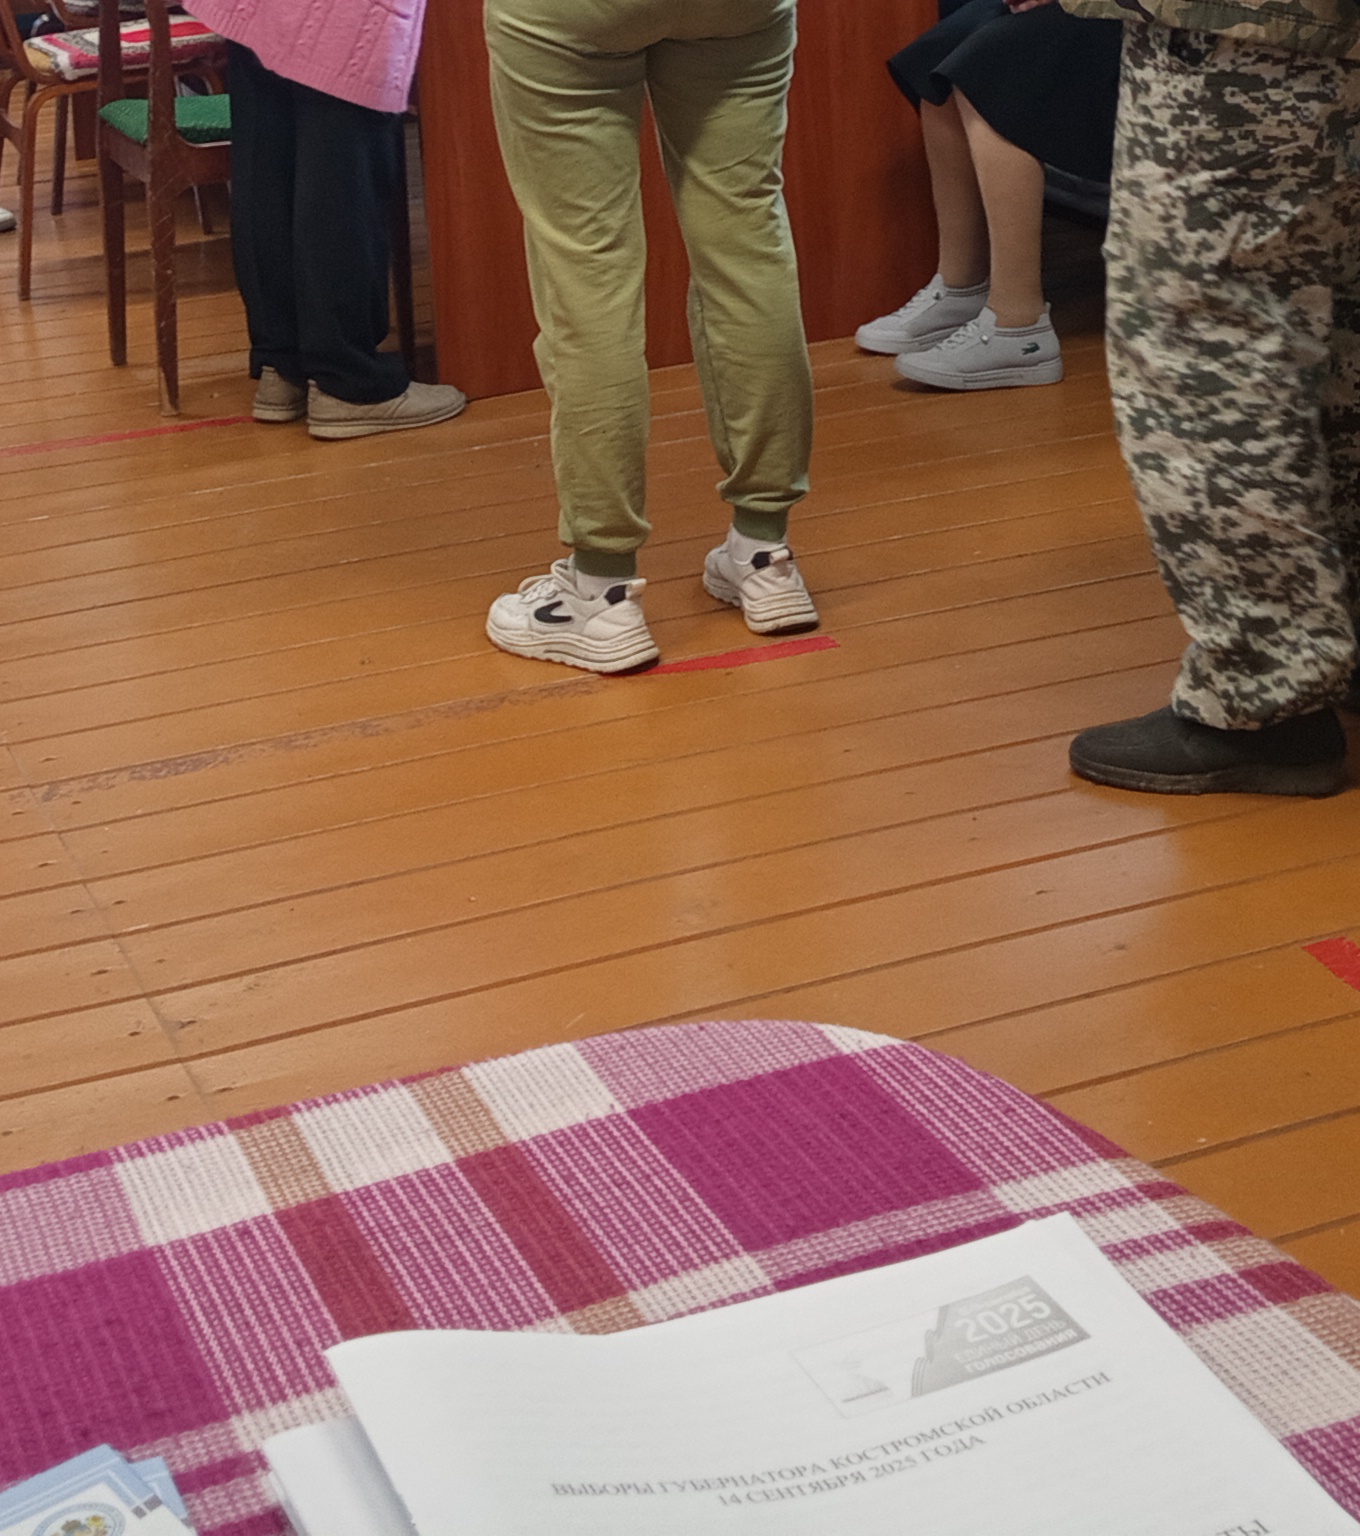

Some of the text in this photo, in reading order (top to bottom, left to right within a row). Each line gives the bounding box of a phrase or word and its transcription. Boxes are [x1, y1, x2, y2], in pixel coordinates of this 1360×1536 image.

[954, 1293, 1052, 1343] 2025
[1025, 1319, 1068, 1341] ДЕНЬ
[964, 1328, 1078, 1373] ГОЛОСОВАНИЯ
[550, 1370, 1113, 1496] ВЫБОРЫ ГУБЕРНАТОРА КОСТРОМСКОЙ ОБЛАСТИ
[718, 1433, 986, 1506] 14 СЕНТЯБРЯ 2025 ГОДА
